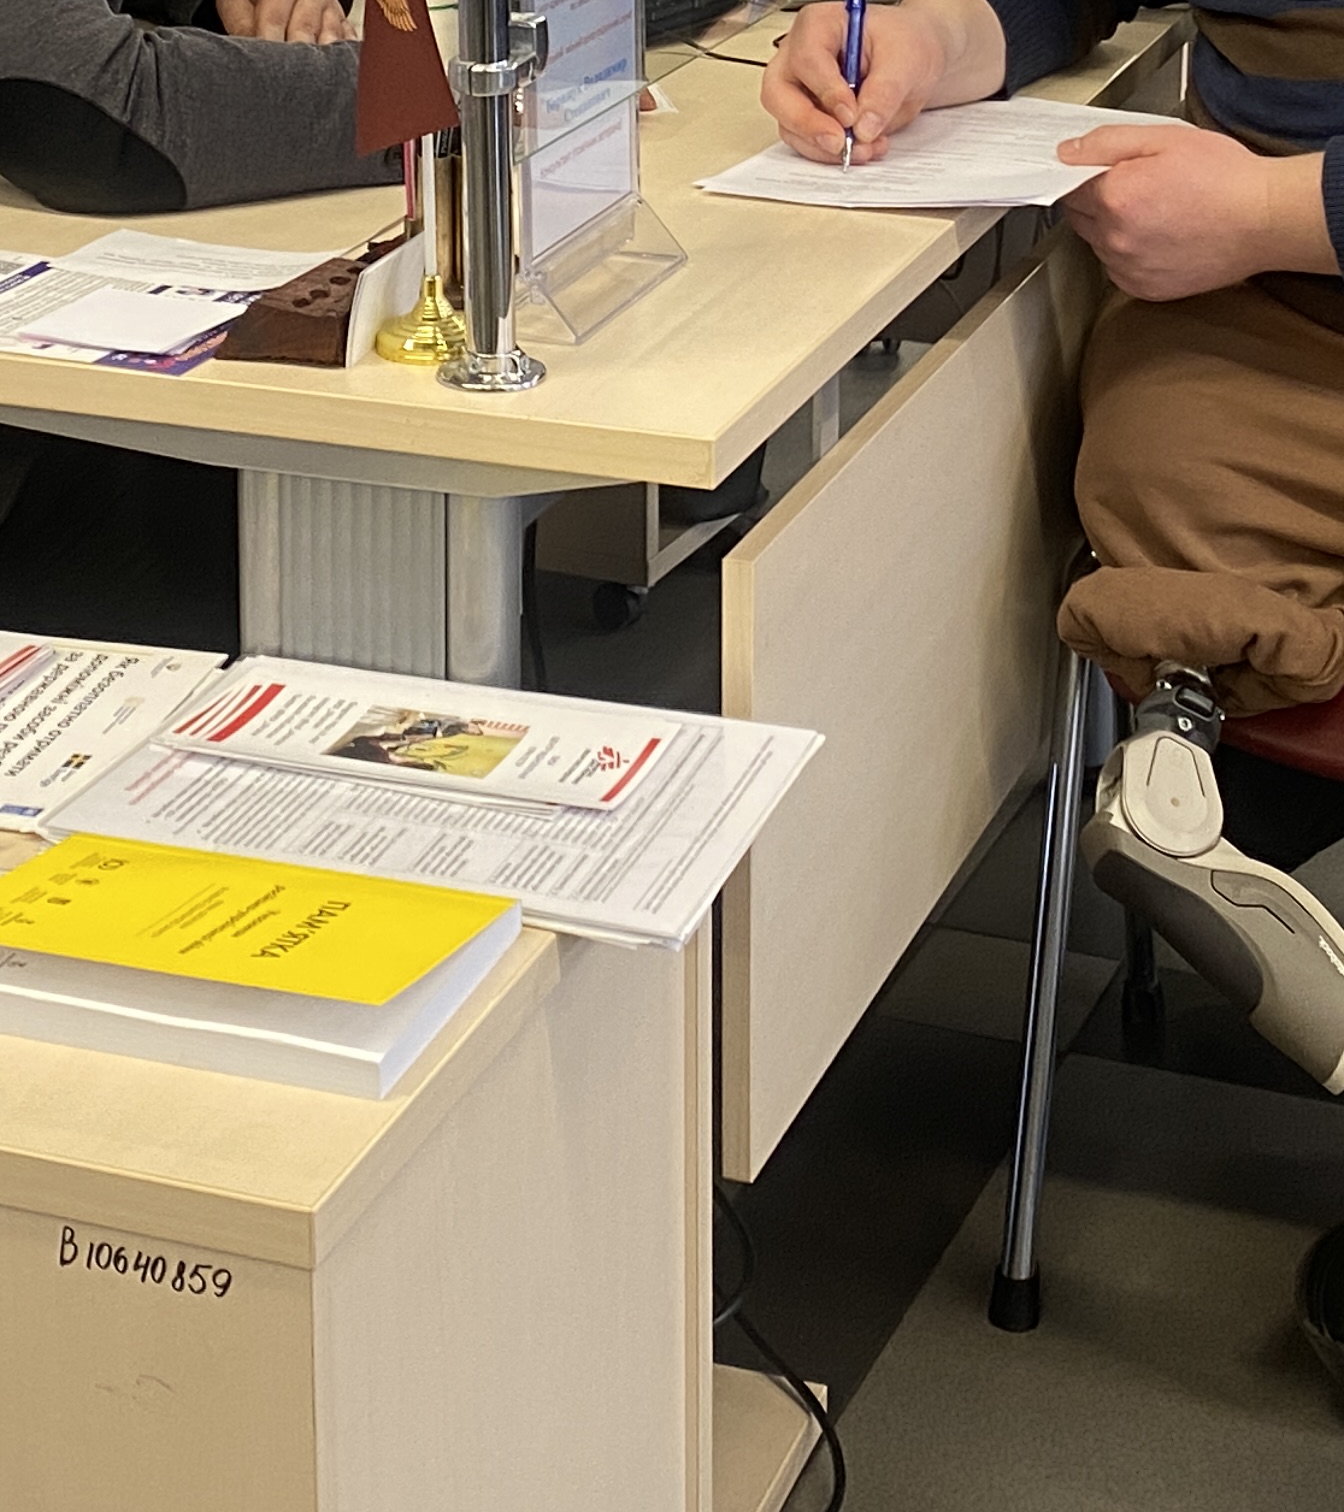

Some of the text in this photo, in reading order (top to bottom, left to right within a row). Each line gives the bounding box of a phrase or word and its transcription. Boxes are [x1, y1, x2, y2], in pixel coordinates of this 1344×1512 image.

[51, 653, 109, 705] допоміжні
[64, 651, 84, 663] за
[121, 655, 140, 670] Як
[3, 662, 70, 722] державною
[57, 668, 125, 728] безоплатно
[16, 704, 59, 742] засоби
[4, 727, 63, 777] отримати
